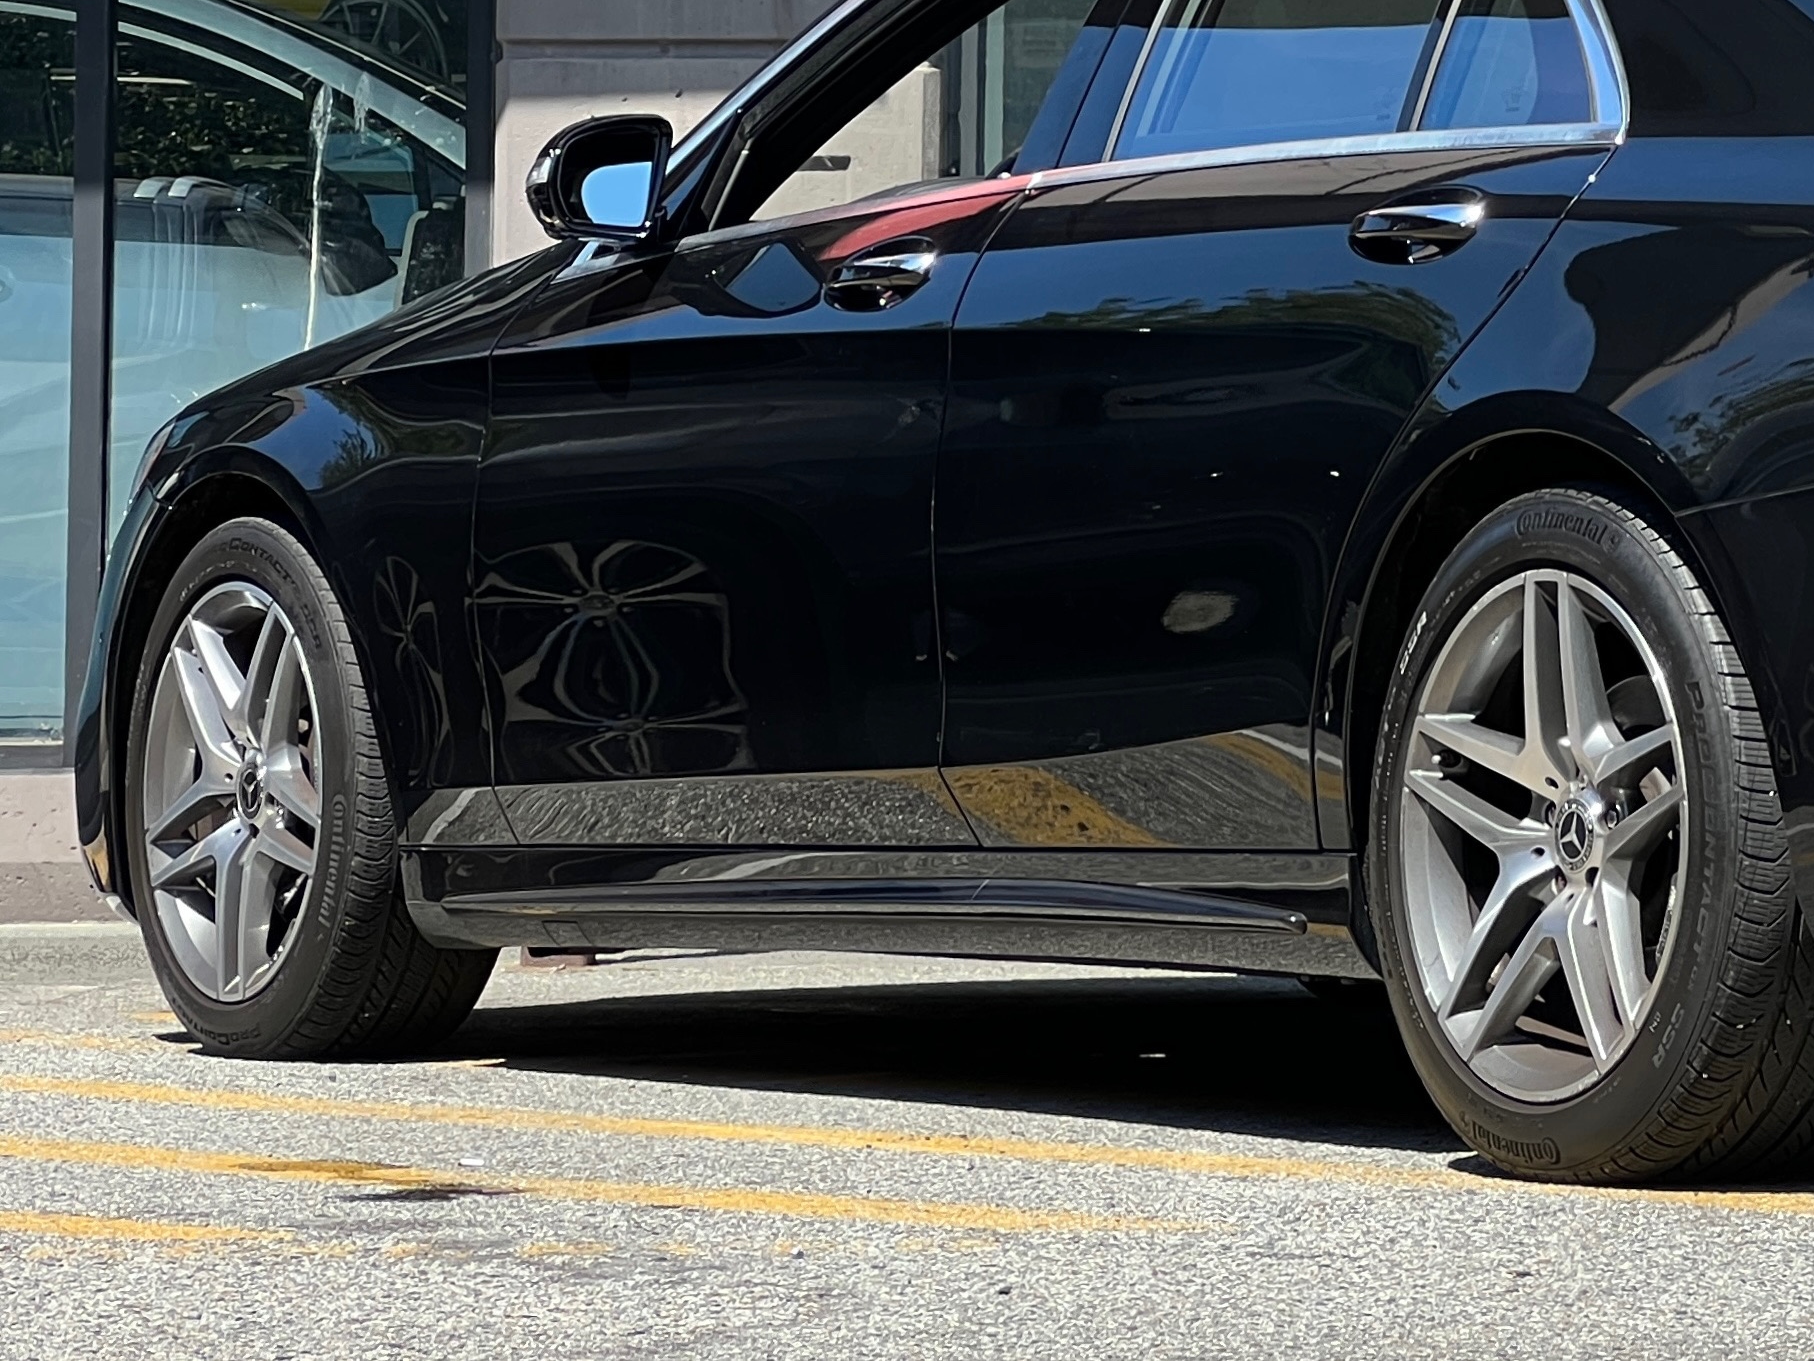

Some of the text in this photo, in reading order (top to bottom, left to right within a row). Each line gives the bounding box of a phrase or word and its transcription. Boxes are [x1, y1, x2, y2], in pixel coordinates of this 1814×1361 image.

[1516, 507, 1608, 545] Continental
[318, 794, 347, 929] Continental
[1652, 1002, 1686, 1069] SSR
[1471, 1120, 1560, 1165] Continental
